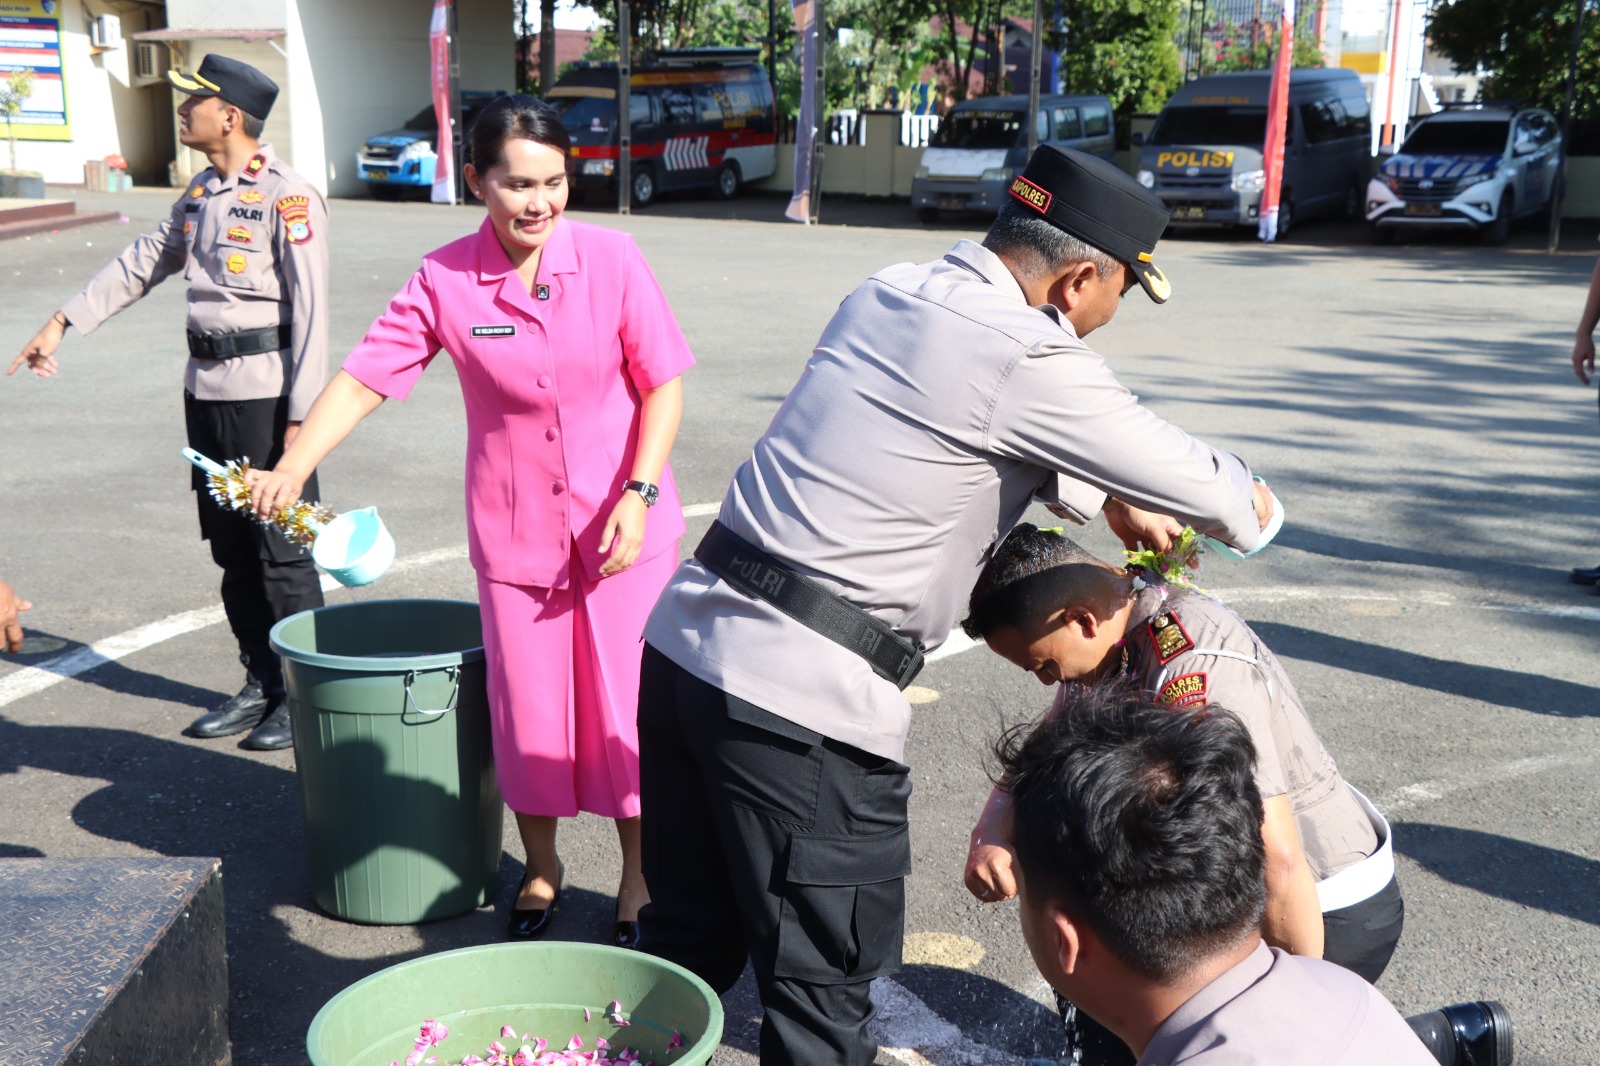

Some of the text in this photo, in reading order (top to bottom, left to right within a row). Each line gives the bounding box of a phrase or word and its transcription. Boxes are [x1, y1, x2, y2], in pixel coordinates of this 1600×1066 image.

[1157, 151, 1235, 168] POLISI
[1011, 179, 1046, 206] KAPOLRES
[228, 206, 263, 222] POLRI
[1182, 683, 1204, 694] LAUT
